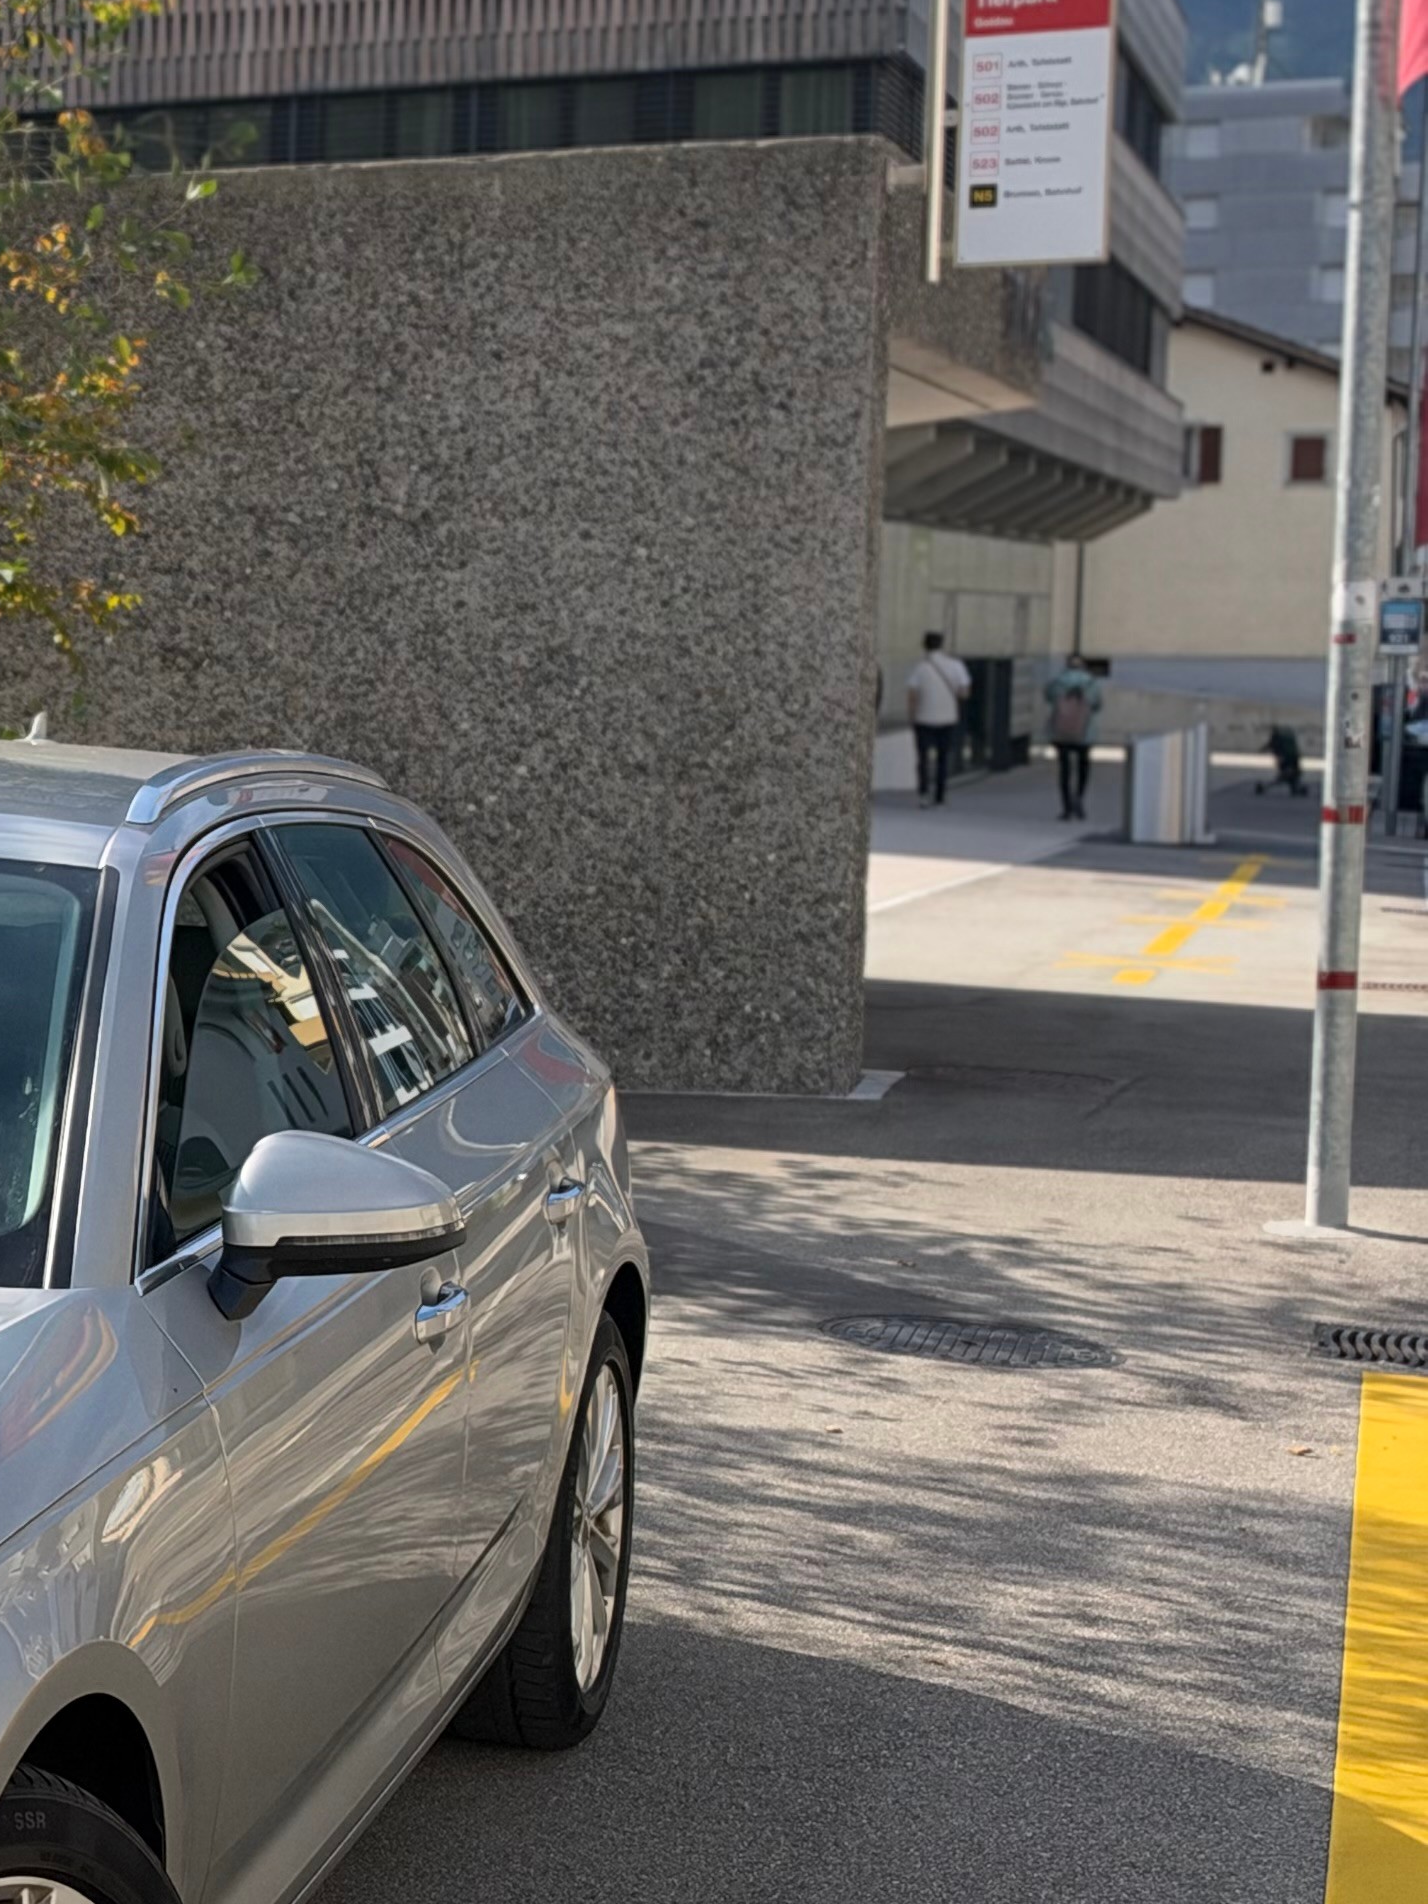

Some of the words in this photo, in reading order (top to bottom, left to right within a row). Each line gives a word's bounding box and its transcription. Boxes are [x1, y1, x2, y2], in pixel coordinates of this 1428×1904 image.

[975, 61, 1000, 73] 501
[974, 93, 1000, 106] 502
[973, 125, 999, 137] 502
[972, 158, 997, 170] 523
[973, 189, 994, 202] N5
[14, 1811, 47, 1830] SSR
